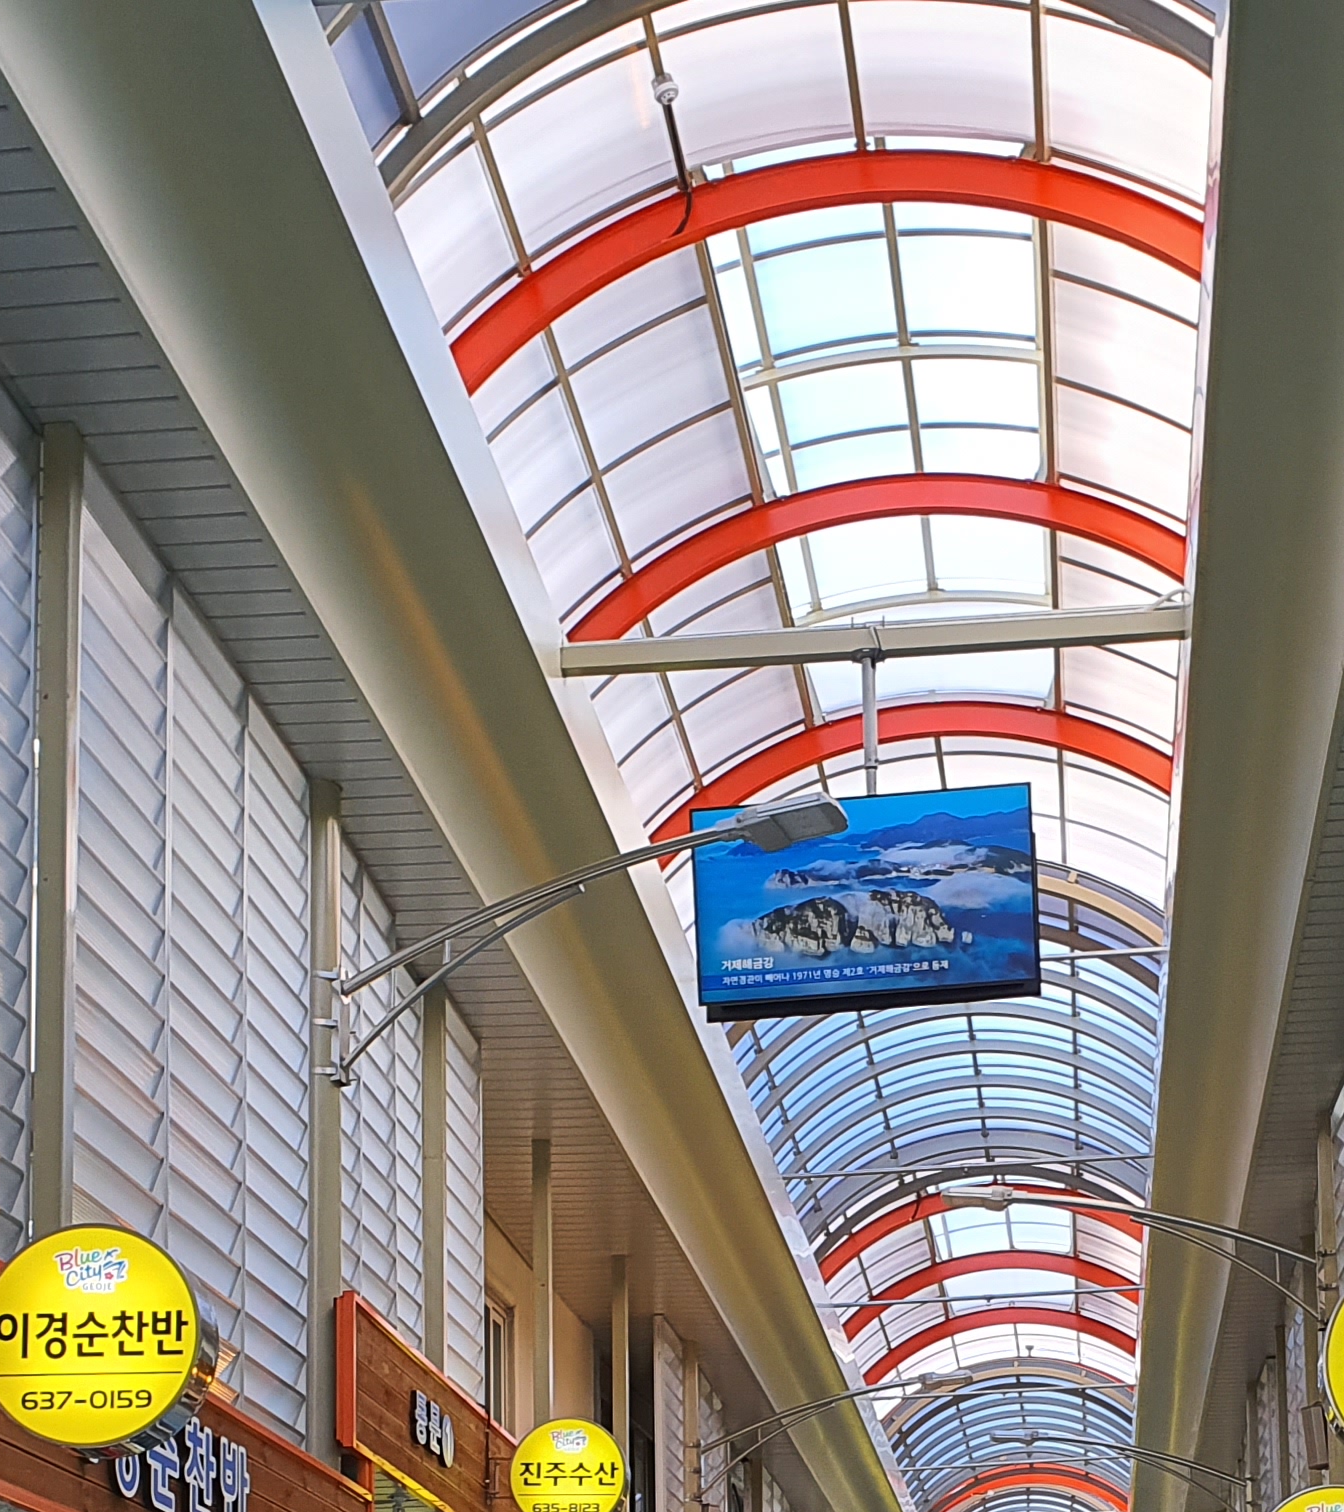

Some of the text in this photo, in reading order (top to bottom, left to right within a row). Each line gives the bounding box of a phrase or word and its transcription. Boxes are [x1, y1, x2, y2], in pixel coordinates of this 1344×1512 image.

[56, 1249, 101, 1271] Blue
[66, 1266, 103, 1286] City
[82, 1281, 113, 1291] GEOJE
[21, 1389, 153, 1411] 637-0159
[519, 1462, 619, 1486] 진주수산
